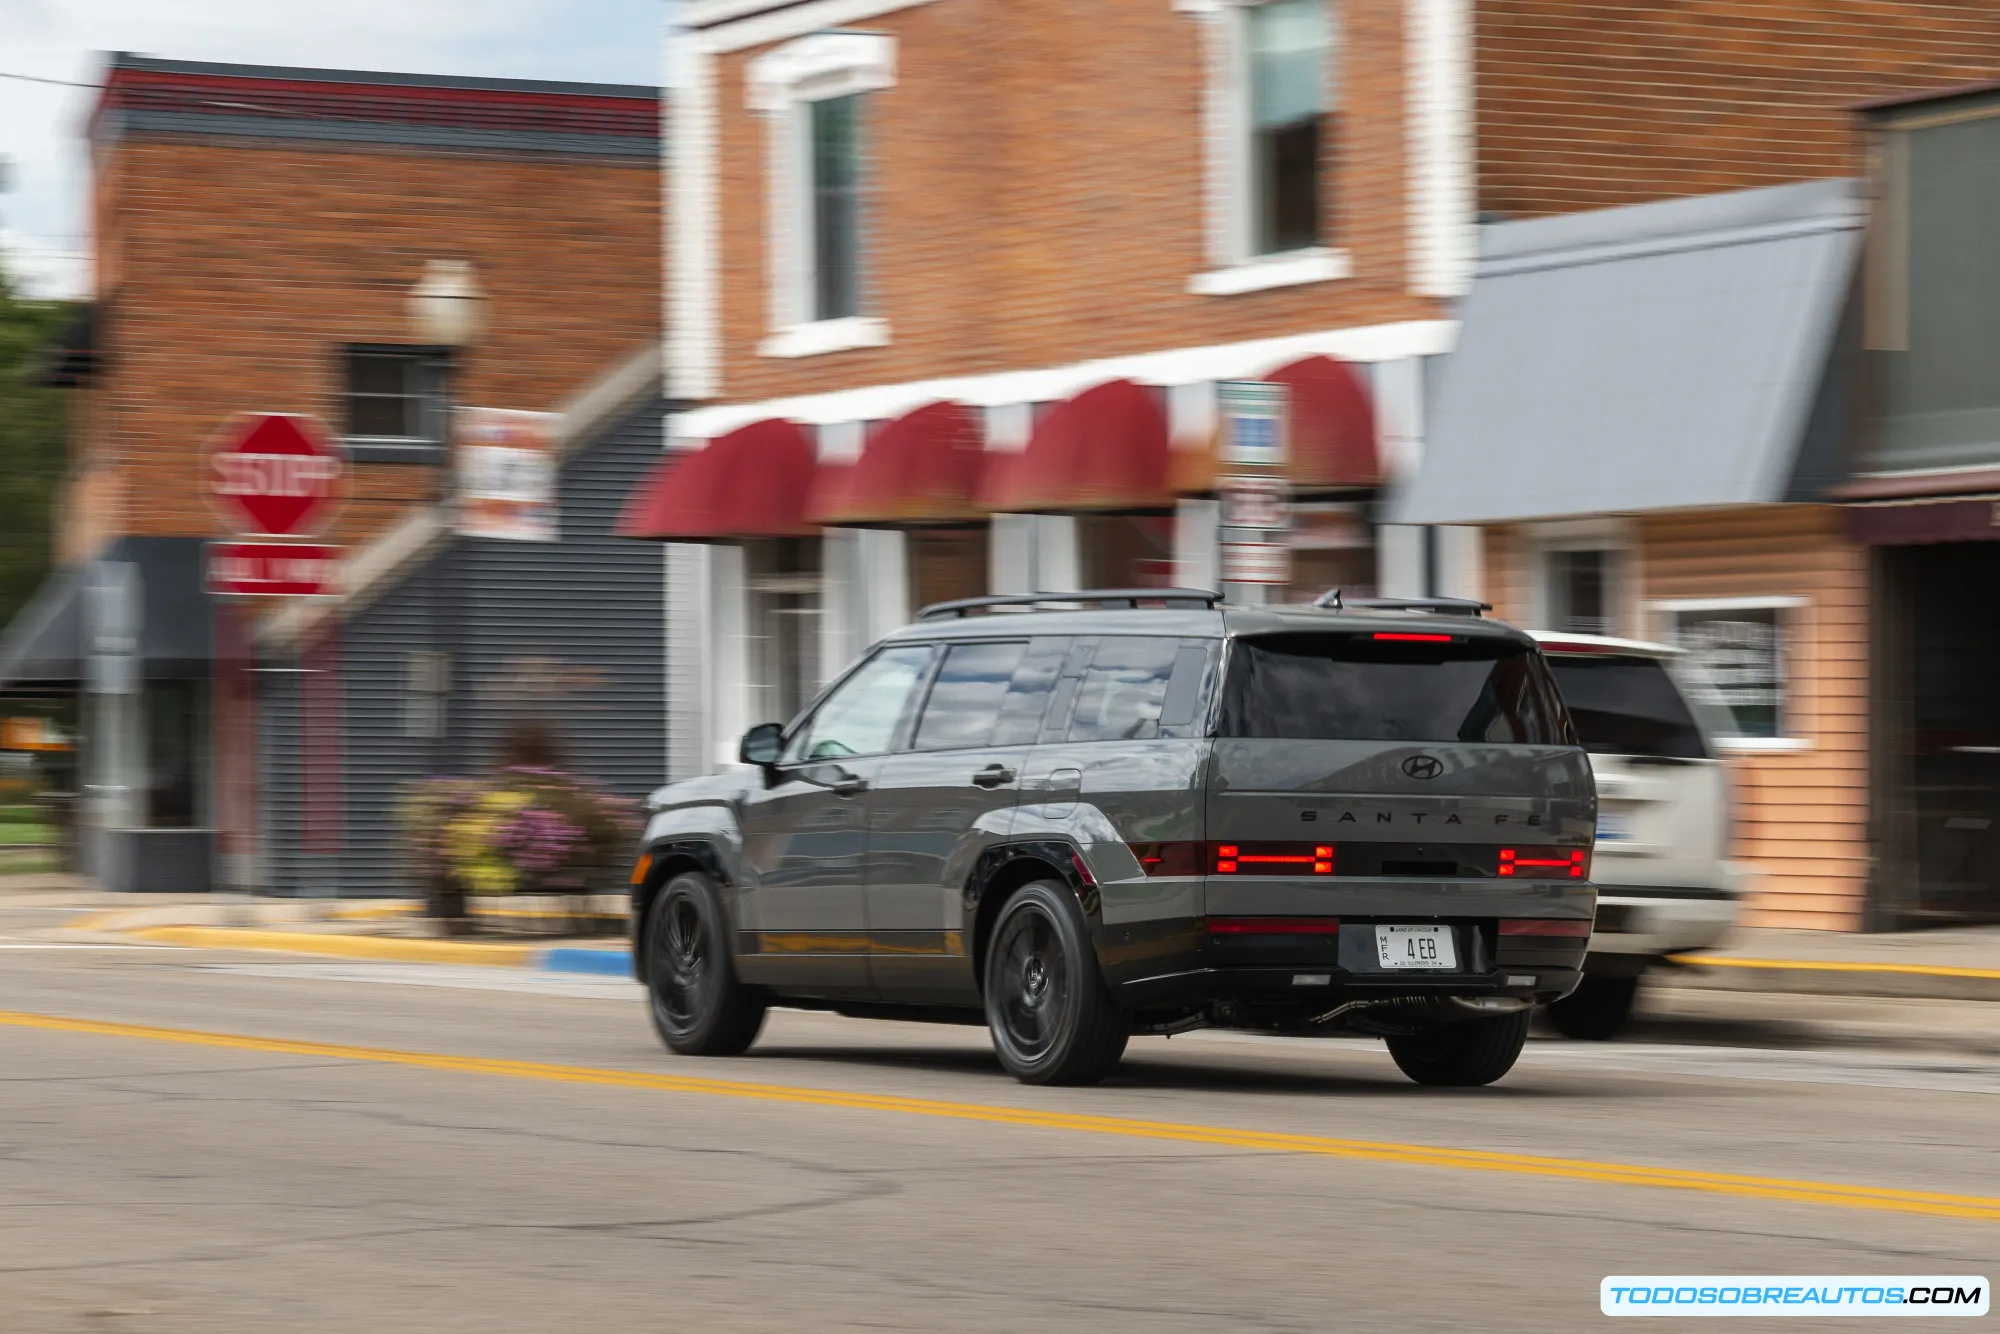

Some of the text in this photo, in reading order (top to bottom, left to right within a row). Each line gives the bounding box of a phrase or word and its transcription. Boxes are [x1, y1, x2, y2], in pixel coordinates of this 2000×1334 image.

[1300, 811, 1541, 826] SANTA FE
[1379, 936, 1389, 960] MFR
[1408, 938, 1436, 959] 4 EB
